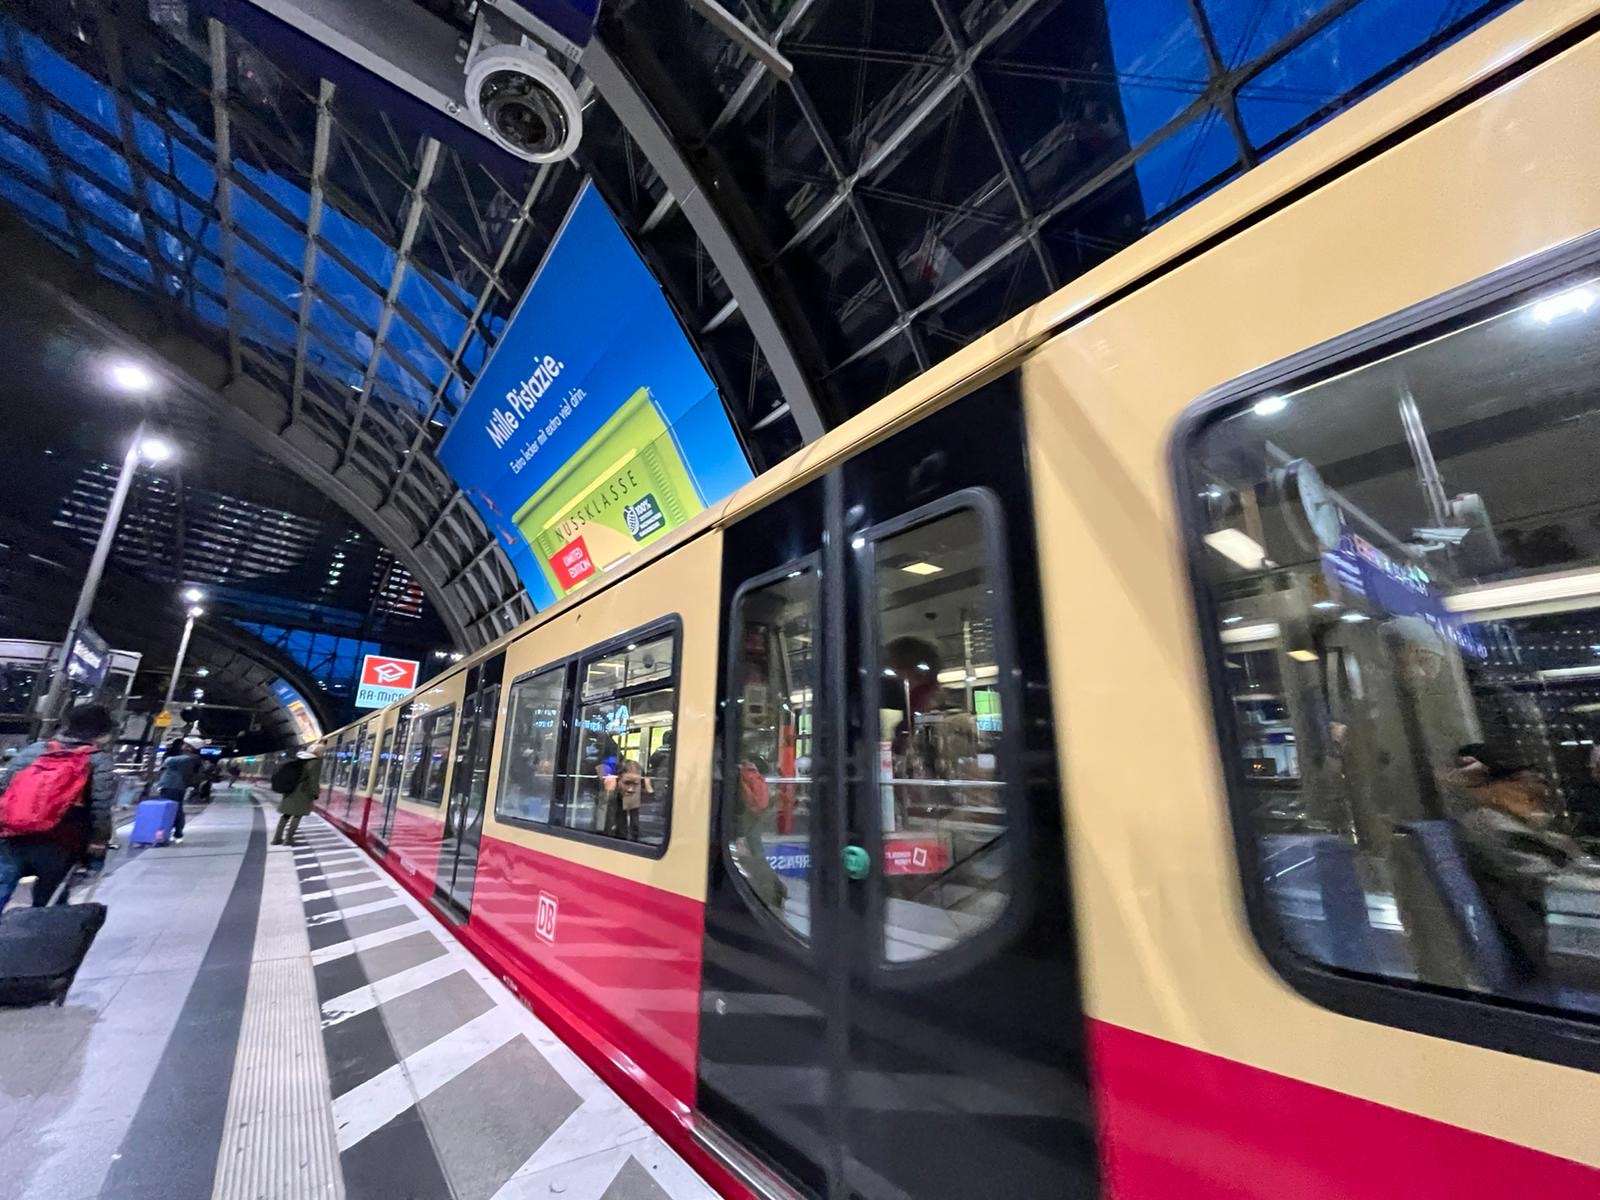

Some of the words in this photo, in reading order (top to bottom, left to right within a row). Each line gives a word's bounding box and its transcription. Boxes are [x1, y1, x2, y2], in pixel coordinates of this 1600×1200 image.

[485, 407, 519, 450] Mille
[506, 355, 565, 419] Pistazie.
[555, 470, 638, 541] NUSSKLASSE
[538, 897, 556, 938] DB
